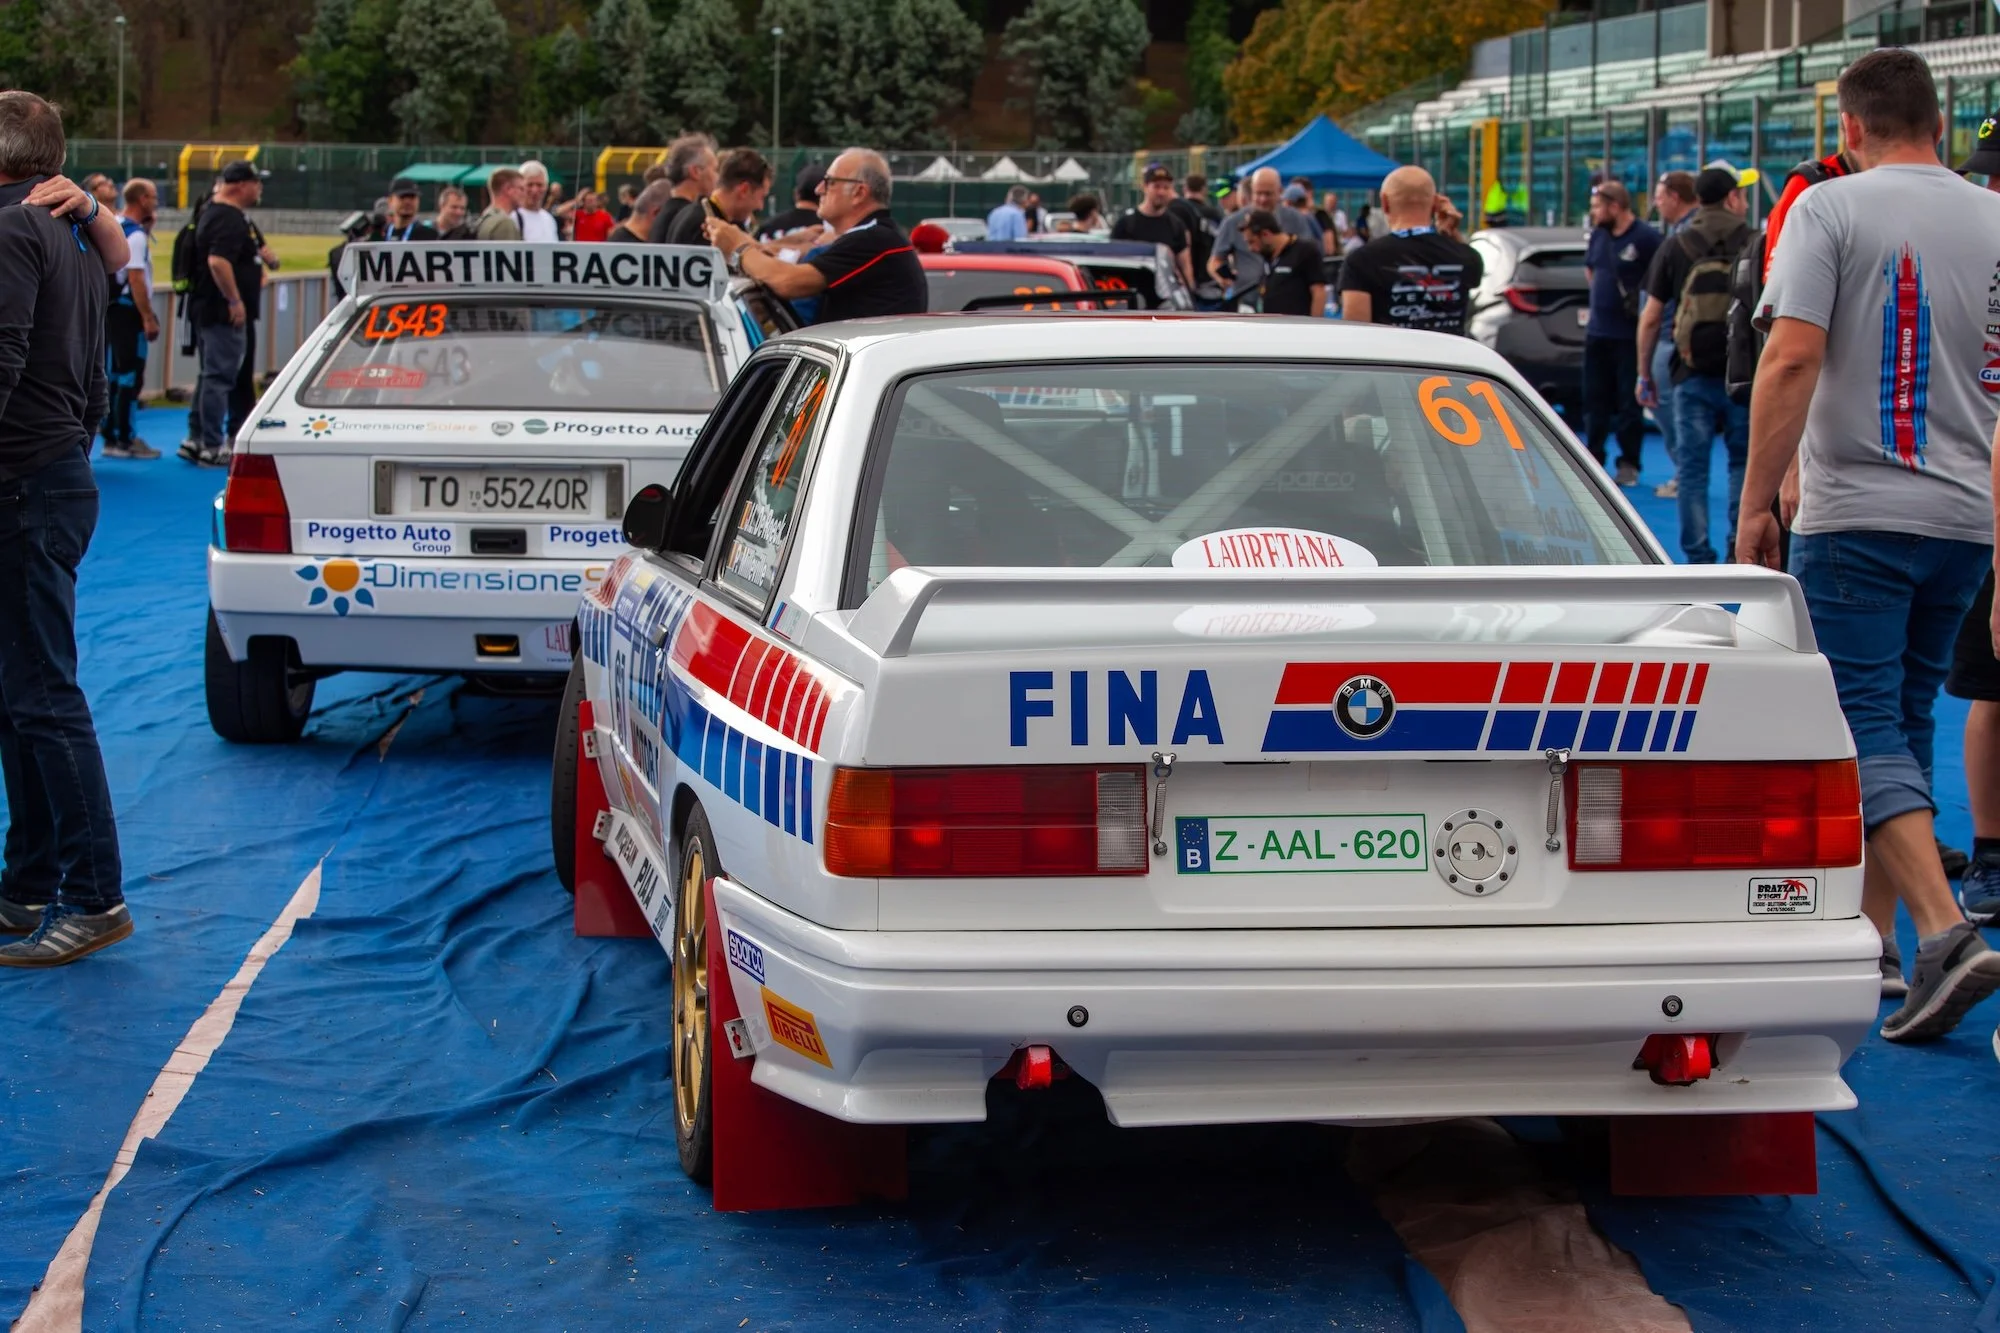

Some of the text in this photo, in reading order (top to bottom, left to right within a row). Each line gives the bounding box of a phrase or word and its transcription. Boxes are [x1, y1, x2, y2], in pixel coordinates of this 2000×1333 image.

[359, 250, 713, 288] MARTINI RACING
[364, 303, 448, 341] LS43
[1901, 327, 1912, 373] LEGEND
[553, 421, 649, 436] Progetto
[1418, 375, 1526, 452] 61
[419, 476, 460, 508] TO
[483, 477, 589, 510] 55240R
[308, 522, 452, 544] Progetto Auto
[412, 541, 452, 554] Group
[1341, 678, 1390, 699] BMW
[1009, 669, 1225, 747] FINA
[1186, 848, 1202, 868] B
[1215, 829, 1421, 861] Z-AAL-620
[633, 856, 659, 911] PIAA
[1757, 884, 1796, 893] BRAZZA
[729, 933, 765, 976] sparco
[766, 1000, 823, 1056] PIRELLI
